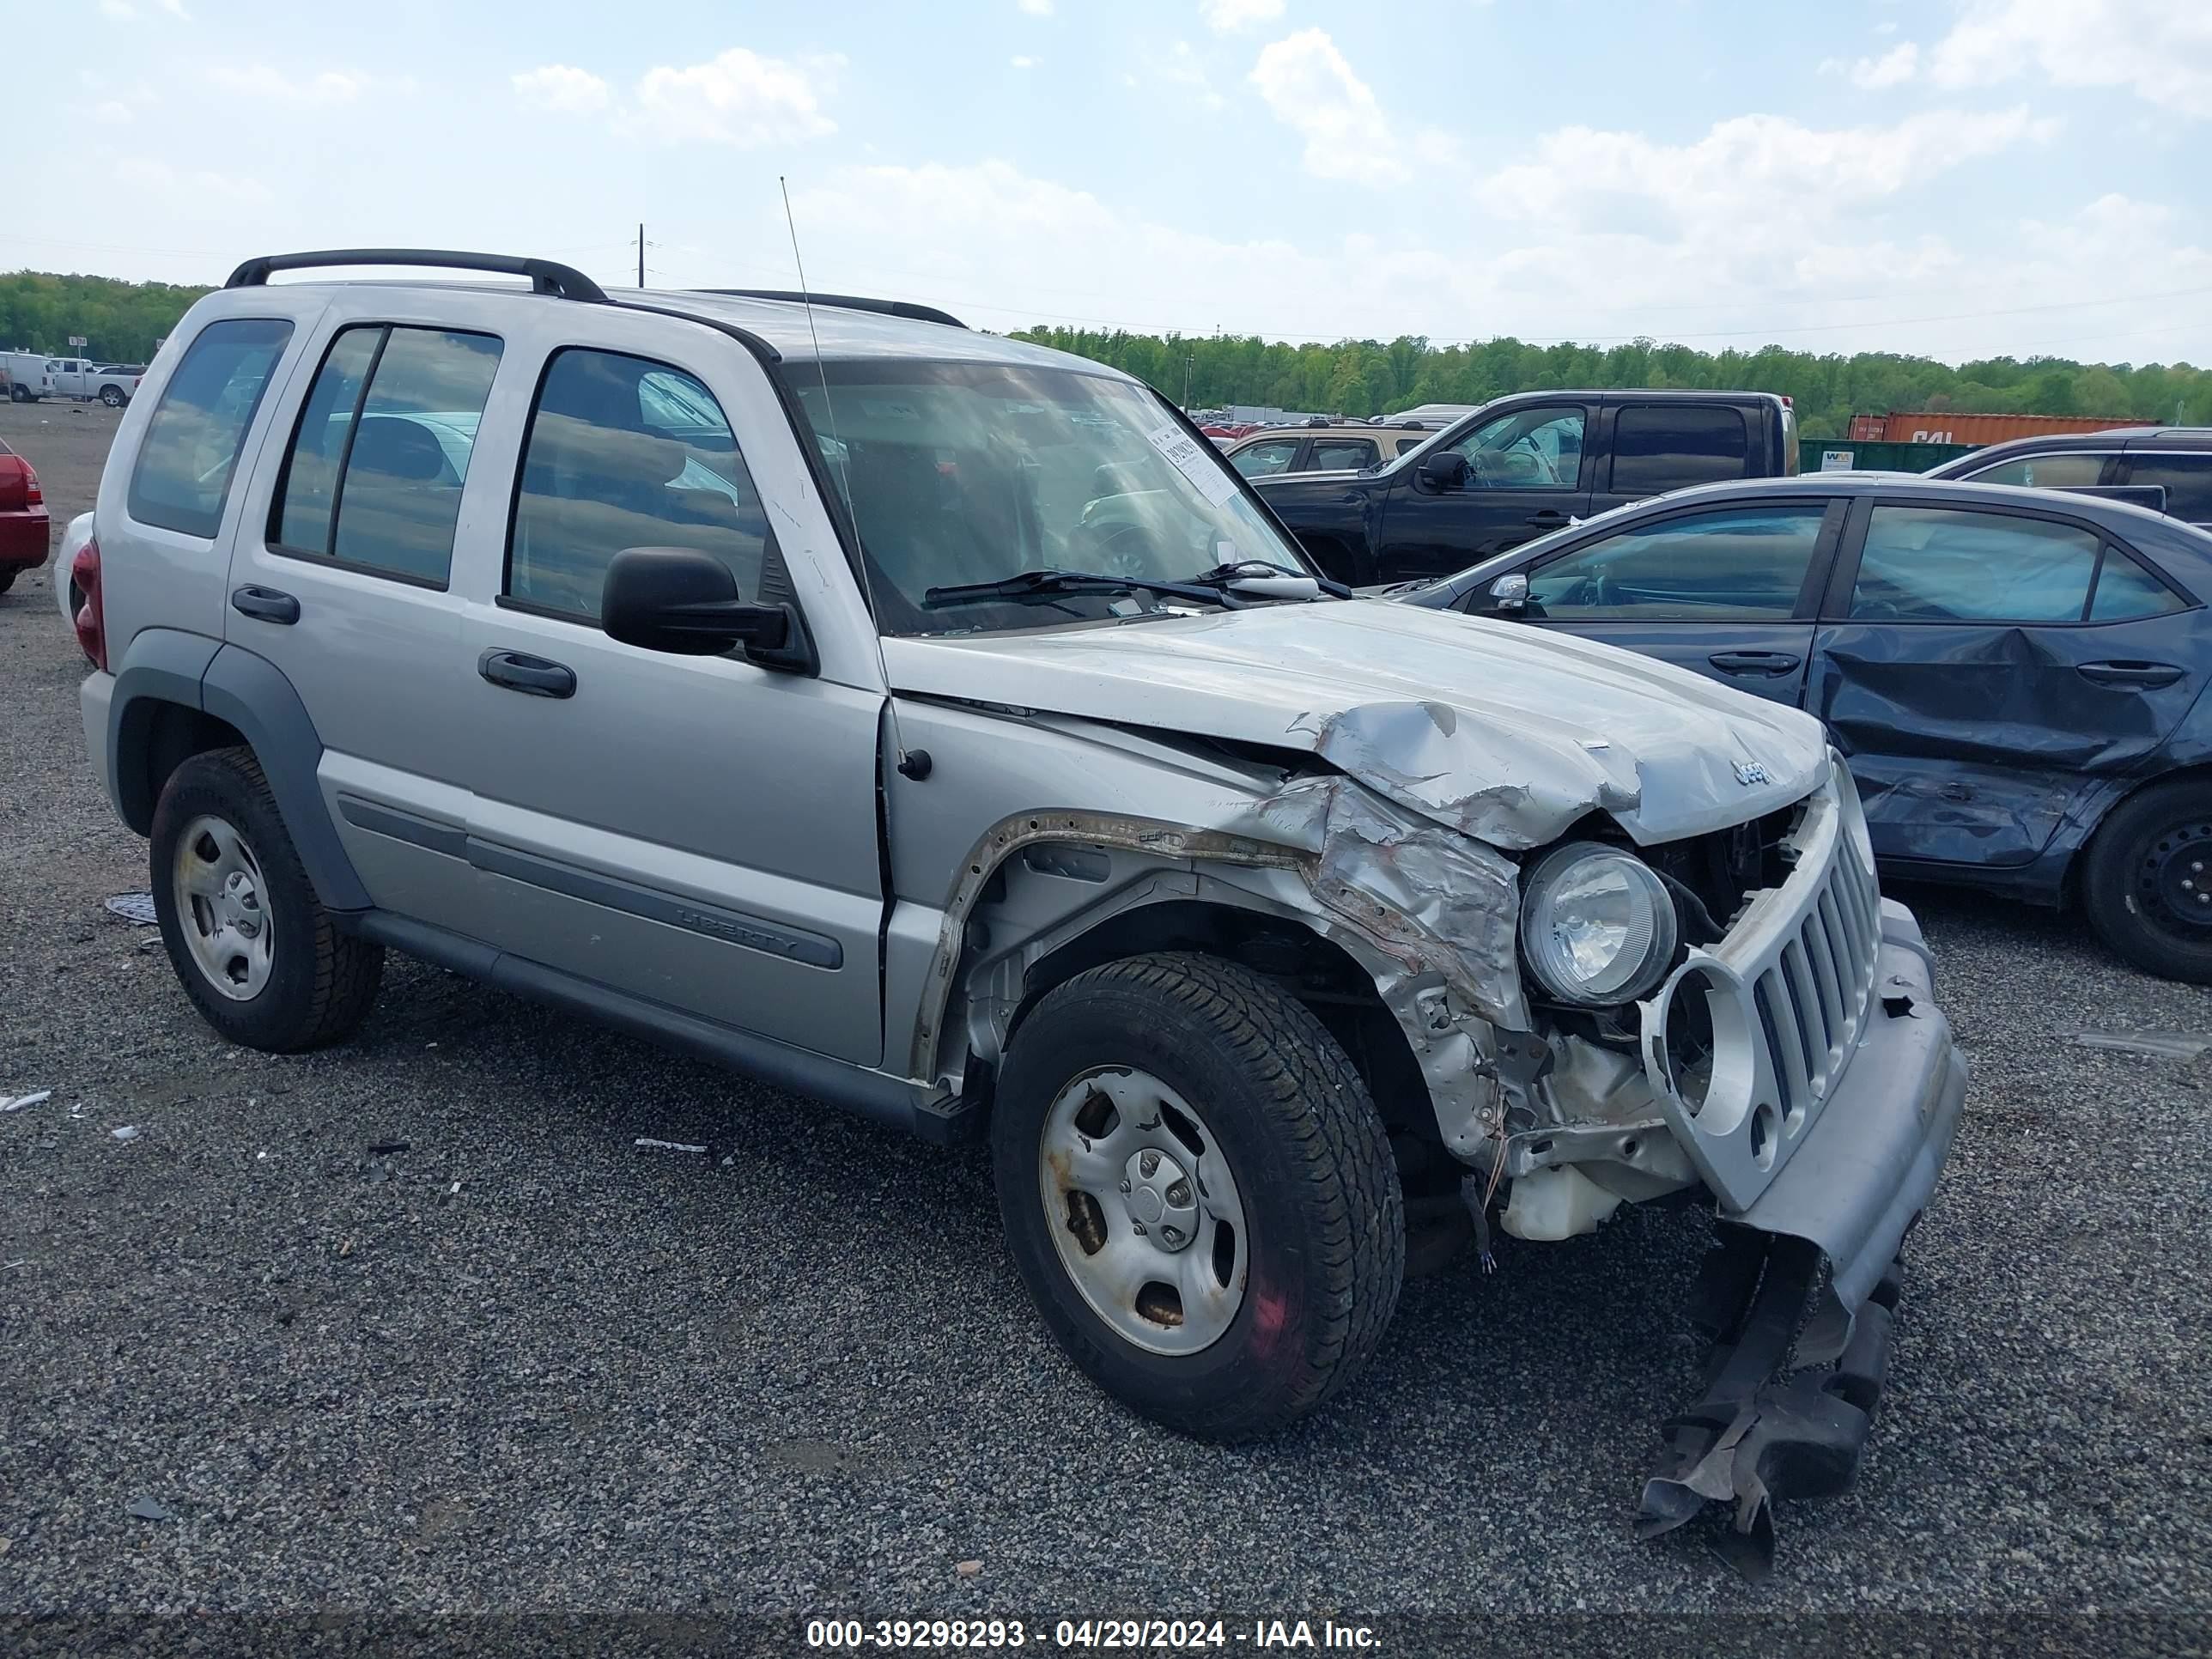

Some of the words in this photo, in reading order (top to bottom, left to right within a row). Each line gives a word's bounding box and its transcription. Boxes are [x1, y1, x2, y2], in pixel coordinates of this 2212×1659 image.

[1826, 453, 1850, 461] WM
[1729, 759, 1770, 786] Jeep
[676, 908, 798, 948] LIBERTY
